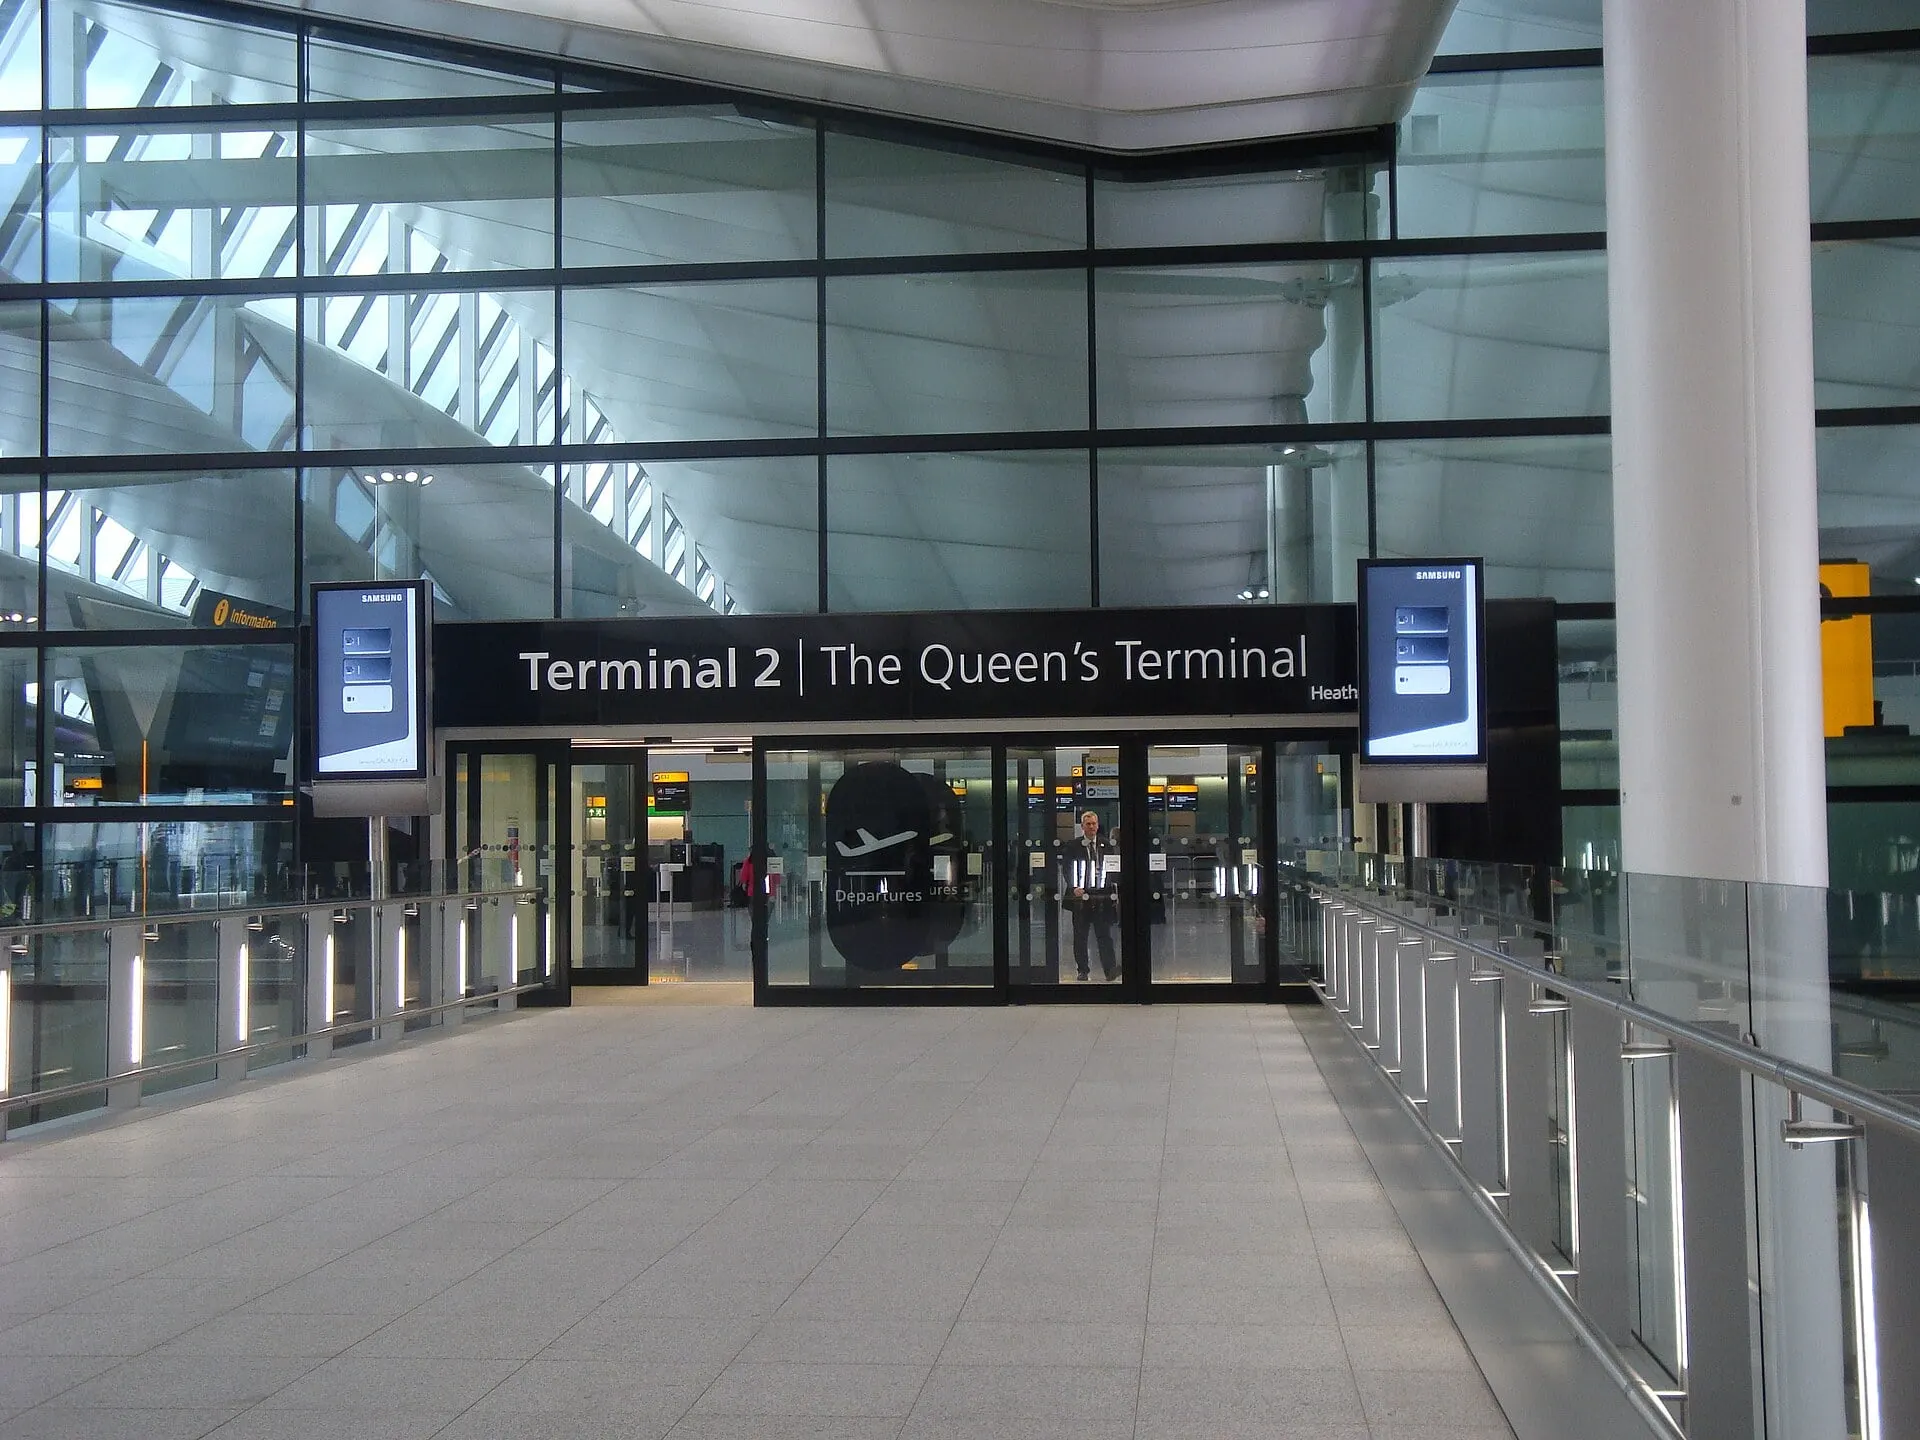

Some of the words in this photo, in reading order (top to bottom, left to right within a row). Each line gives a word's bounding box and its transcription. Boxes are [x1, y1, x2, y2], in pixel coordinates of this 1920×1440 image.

[1416, 571, 1461, 580] SAMSUNG
[361, 594, 403, 604] SAMSUNG
[230, 608, 277, 628] Information
[519, 647, 736, 691] Terminal
[754, 647, 781, 688] 2
[820, 644, 901, 686] The
[919, 642, 1099, 691] Queen’s
[1115, 635, 1307, 681] Terminal
[835, 889, 922, 906] Departures
